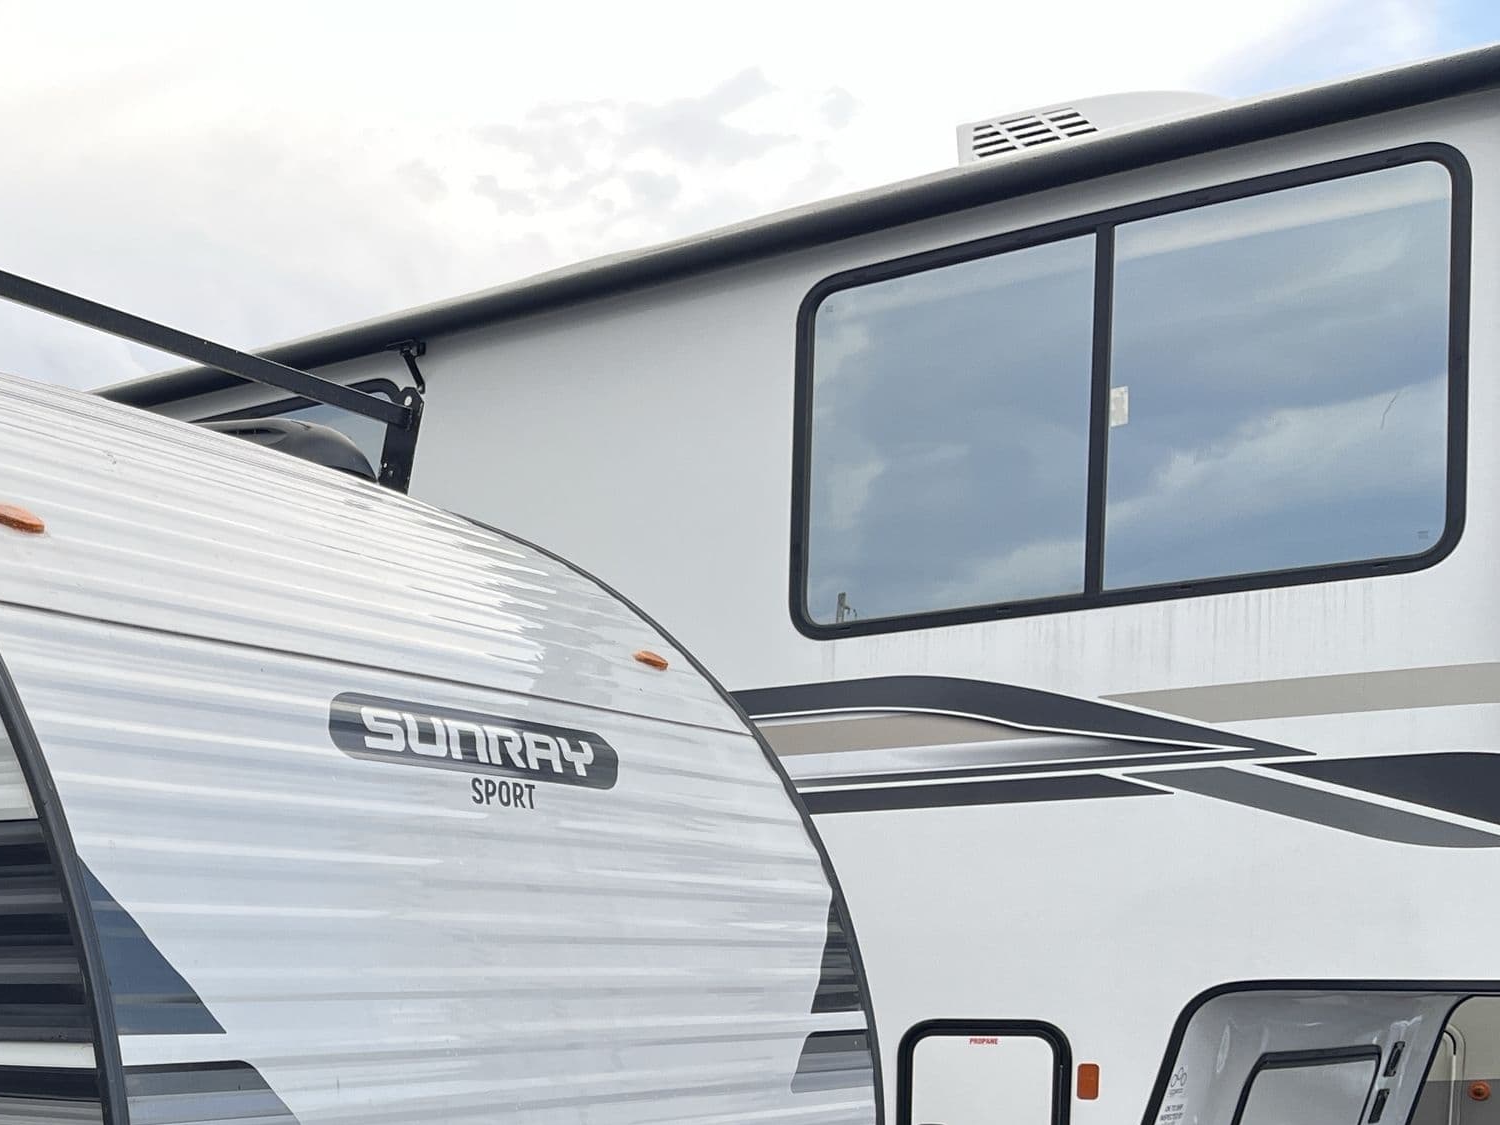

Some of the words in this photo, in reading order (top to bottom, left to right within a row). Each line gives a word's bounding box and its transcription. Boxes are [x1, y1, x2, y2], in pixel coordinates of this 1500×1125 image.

[360, 707, 595, 777] SUNRAY
[471, 777, 536, 810] SPORT
[969, 1037, 998, 1045] PROPANE
